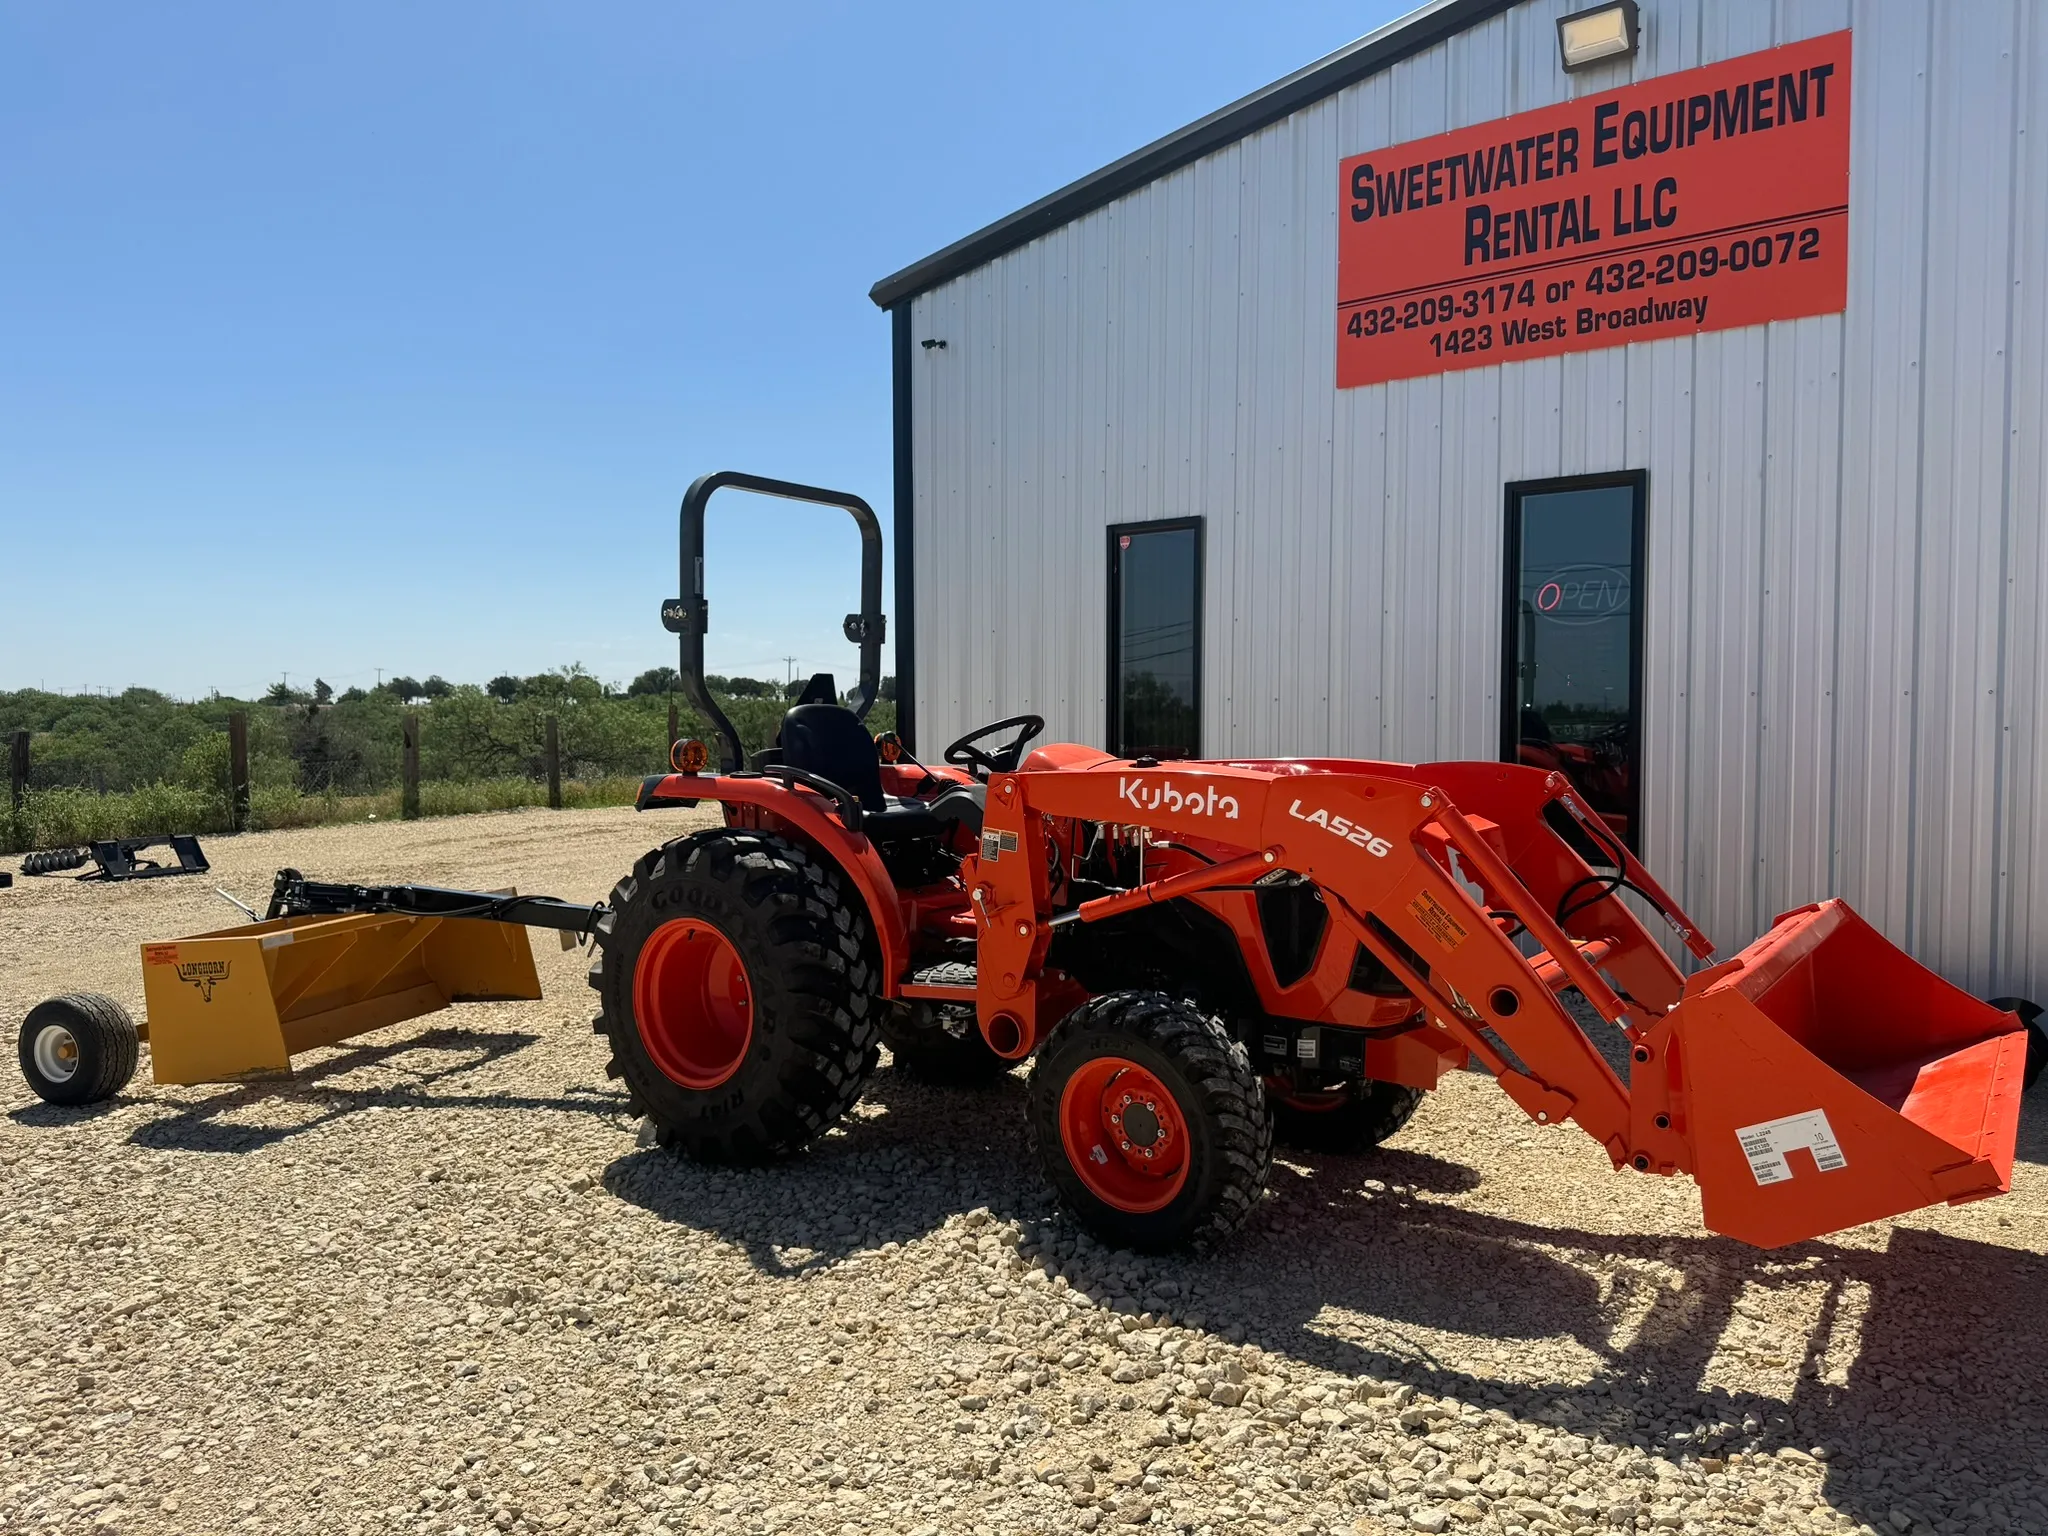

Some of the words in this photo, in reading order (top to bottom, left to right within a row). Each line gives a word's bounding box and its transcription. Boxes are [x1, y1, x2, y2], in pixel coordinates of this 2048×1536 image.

[1351, 126, 1579, 223] SWEETWATER
[1593, 63, 1834, 168] EQUIPMENT
[1464, 197, 1599, 266] RENTAL
[1613, 177, 1678, 237] LLC
[1347, 279, 1535, 339] 432-209-3174
[1545, 276, 1575, 304] or
[1585, 228, 1820, 296] 432-209-0072
[1430, 323, 1493, 358] 1423
[1502, 315, 1566, 347] West
[1576, 295, 1708, 336] Broadway
[1538, 579, 1622, 610] OPEN
[1119, 777, 1239, 819] Kubota
[1289, 799, 1393, 857] LA526
[181, 961, 225, 976] LONGHORN
[1814, 1132, 1824, 1141] 10
